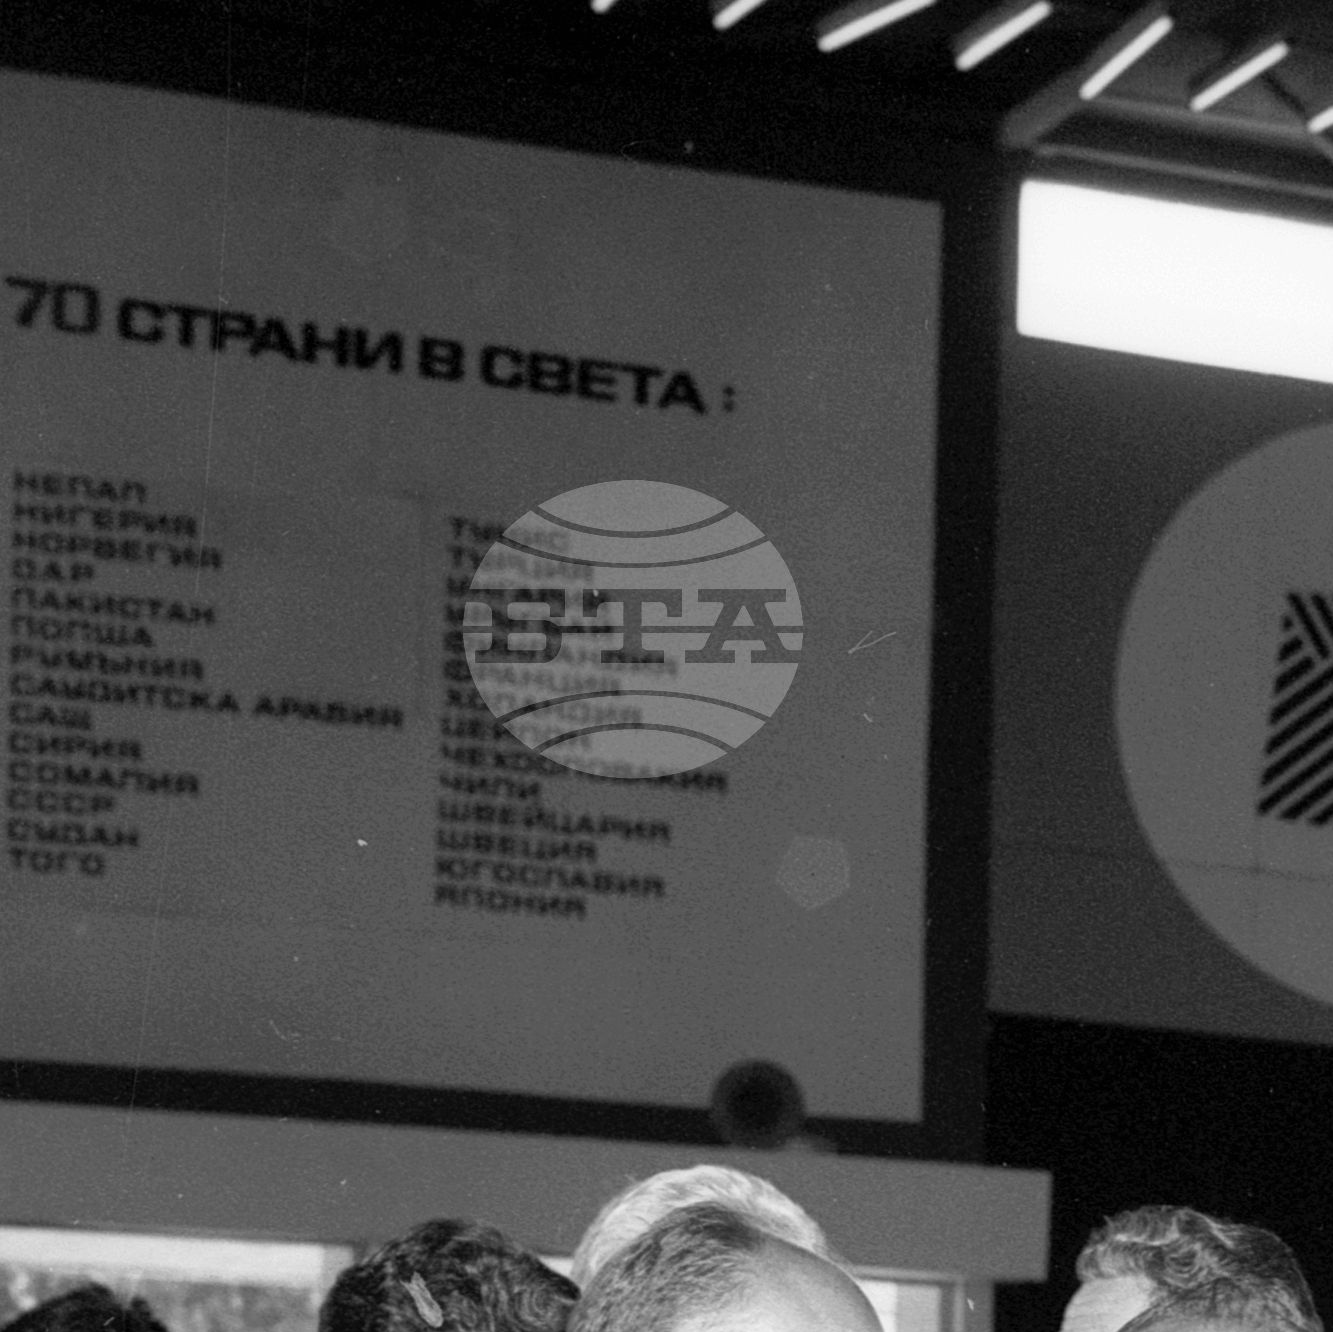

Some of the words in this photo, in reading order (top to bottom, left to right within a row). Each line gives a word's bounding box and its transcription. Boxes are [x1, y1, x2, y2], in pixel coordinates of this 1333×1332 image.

[5, 275, 101, 335] 70
[116, 298, 404, 373] СТРАНИ
[417, 335, 467, 382] В
[9, 847, 105, 877] ТОГО
